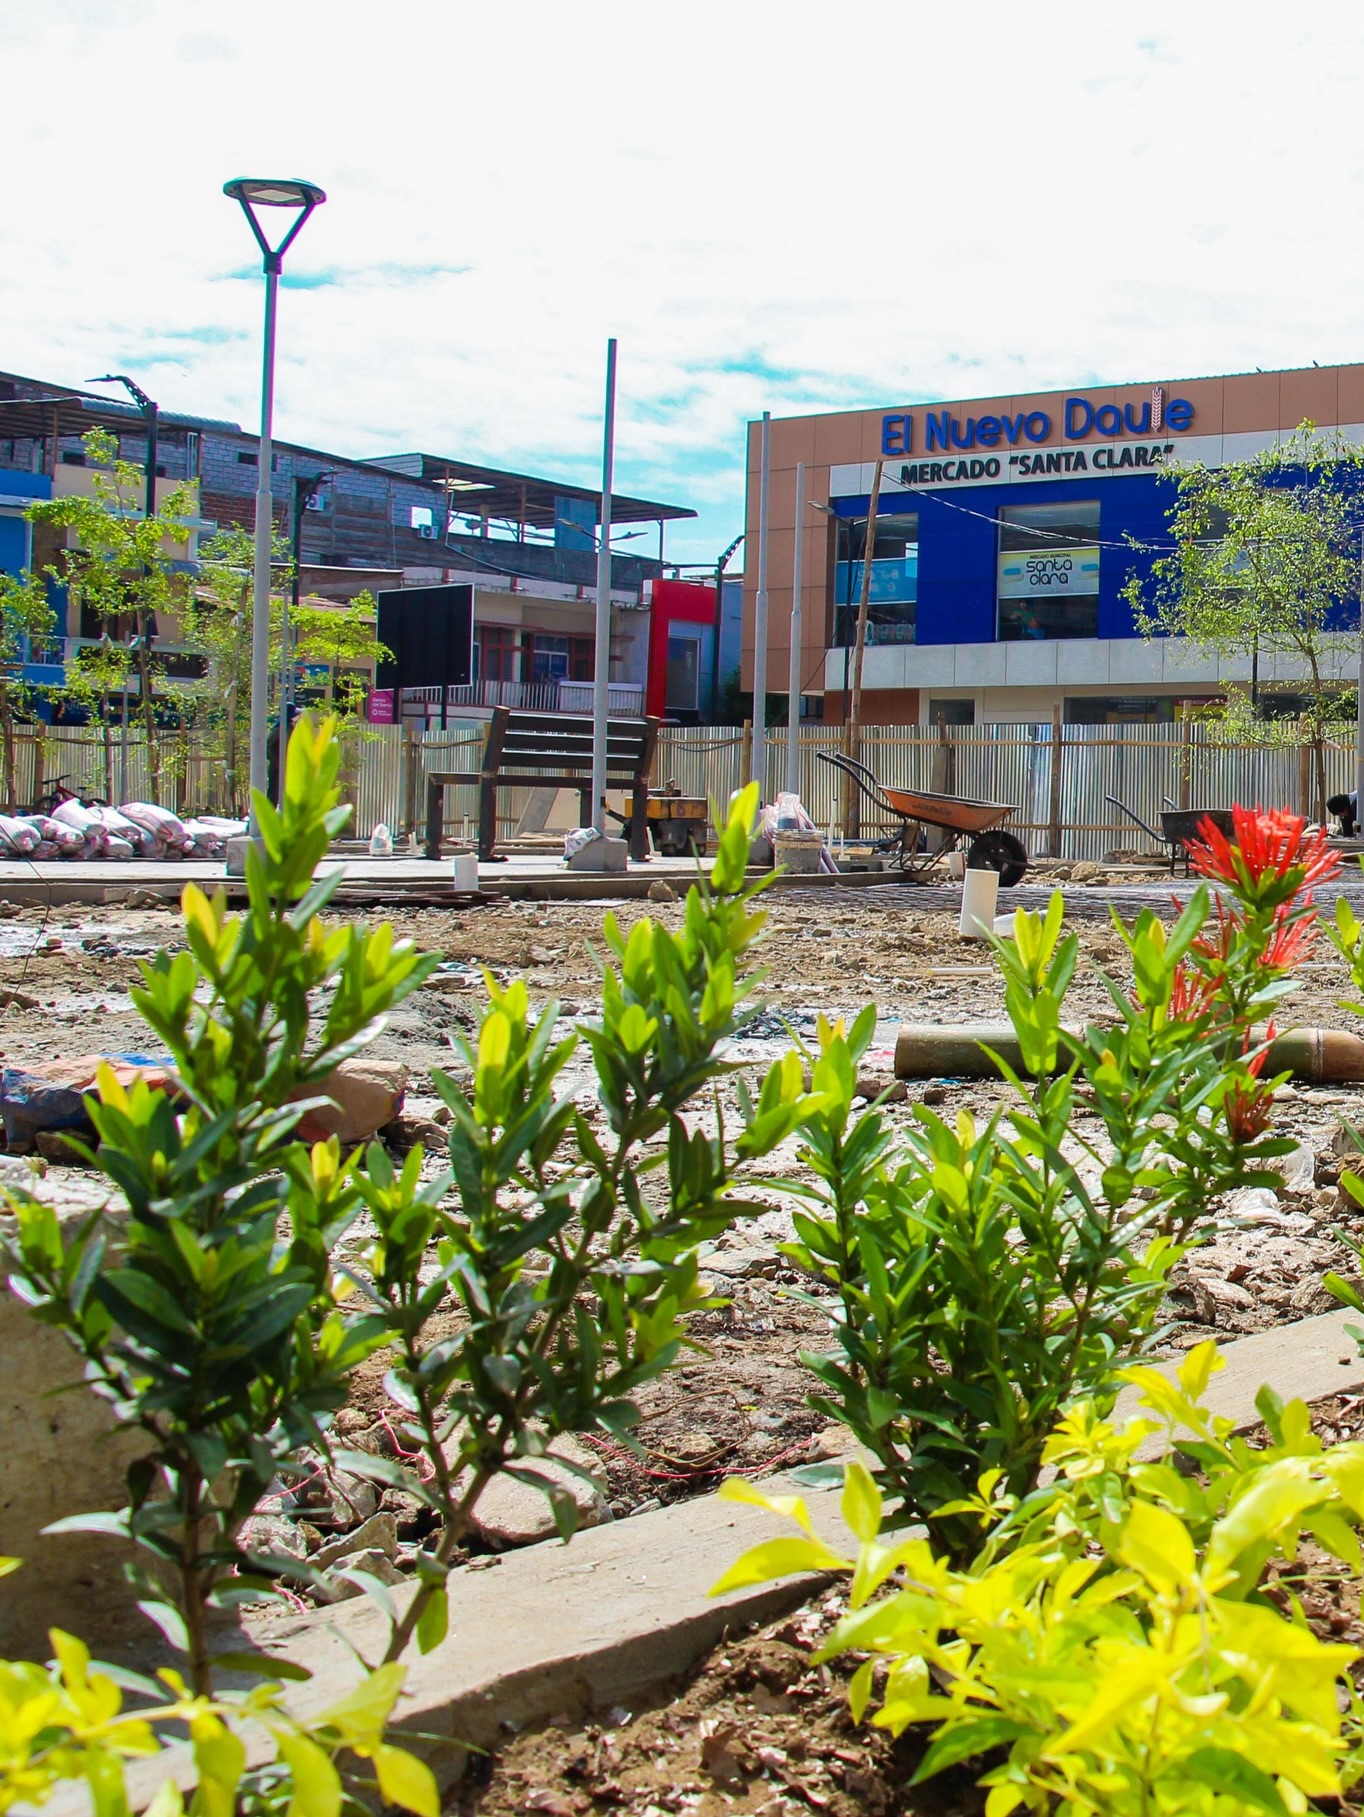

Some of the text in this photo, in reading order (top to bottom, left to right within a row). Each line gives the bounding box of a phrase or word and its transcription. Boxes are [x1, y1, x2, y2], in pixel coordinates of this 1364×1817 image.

[881, 386, 1194, 456] El Nuevo Daule
[900, 458, 1001, 485] MERCADO
[1026, 558, 1073, 573] santa
[1030, 571, 1069, 586] clara
